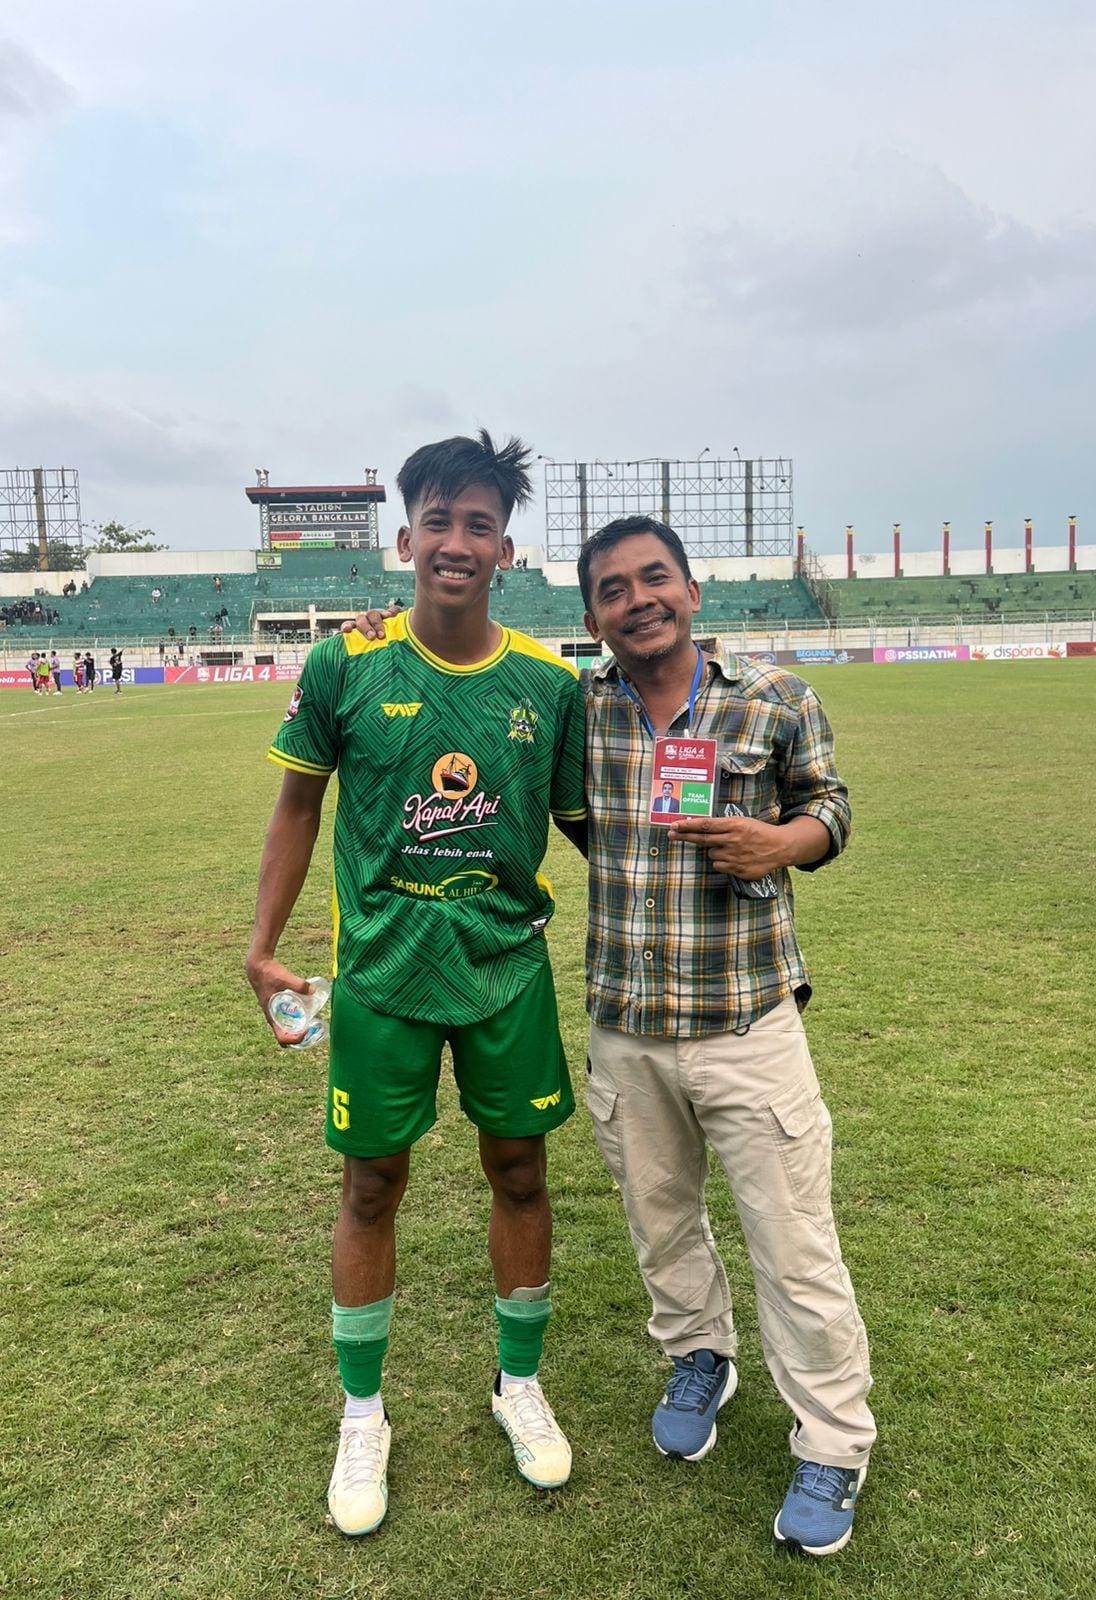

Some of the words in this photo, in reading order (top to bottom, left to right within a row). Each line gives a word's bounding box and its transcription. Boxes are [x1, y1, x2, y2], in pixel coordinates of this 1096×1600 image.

[295, 504, 342, 512] STADION
[271, 514, 308, 522] GELORA
[311, 513, 367, 521] BANGKALAN
[897, 649, 957, 660] PSSIJATIM
[993, 646, 1044, 662] dispora
[102, 668, 135, 682] PSI
[213, 667, 255, 682] LIGA
[258, 667, 271, 681] 4
[678, 746, 697, 754] LIGA
[402, 792, 464, 834] Kapal
[460, 791, 501, 824] Api
[433, 847, 463, 858] lebih
[466, 849, 494, 859] enak
[390, 875, 445, 897] SARUNG
